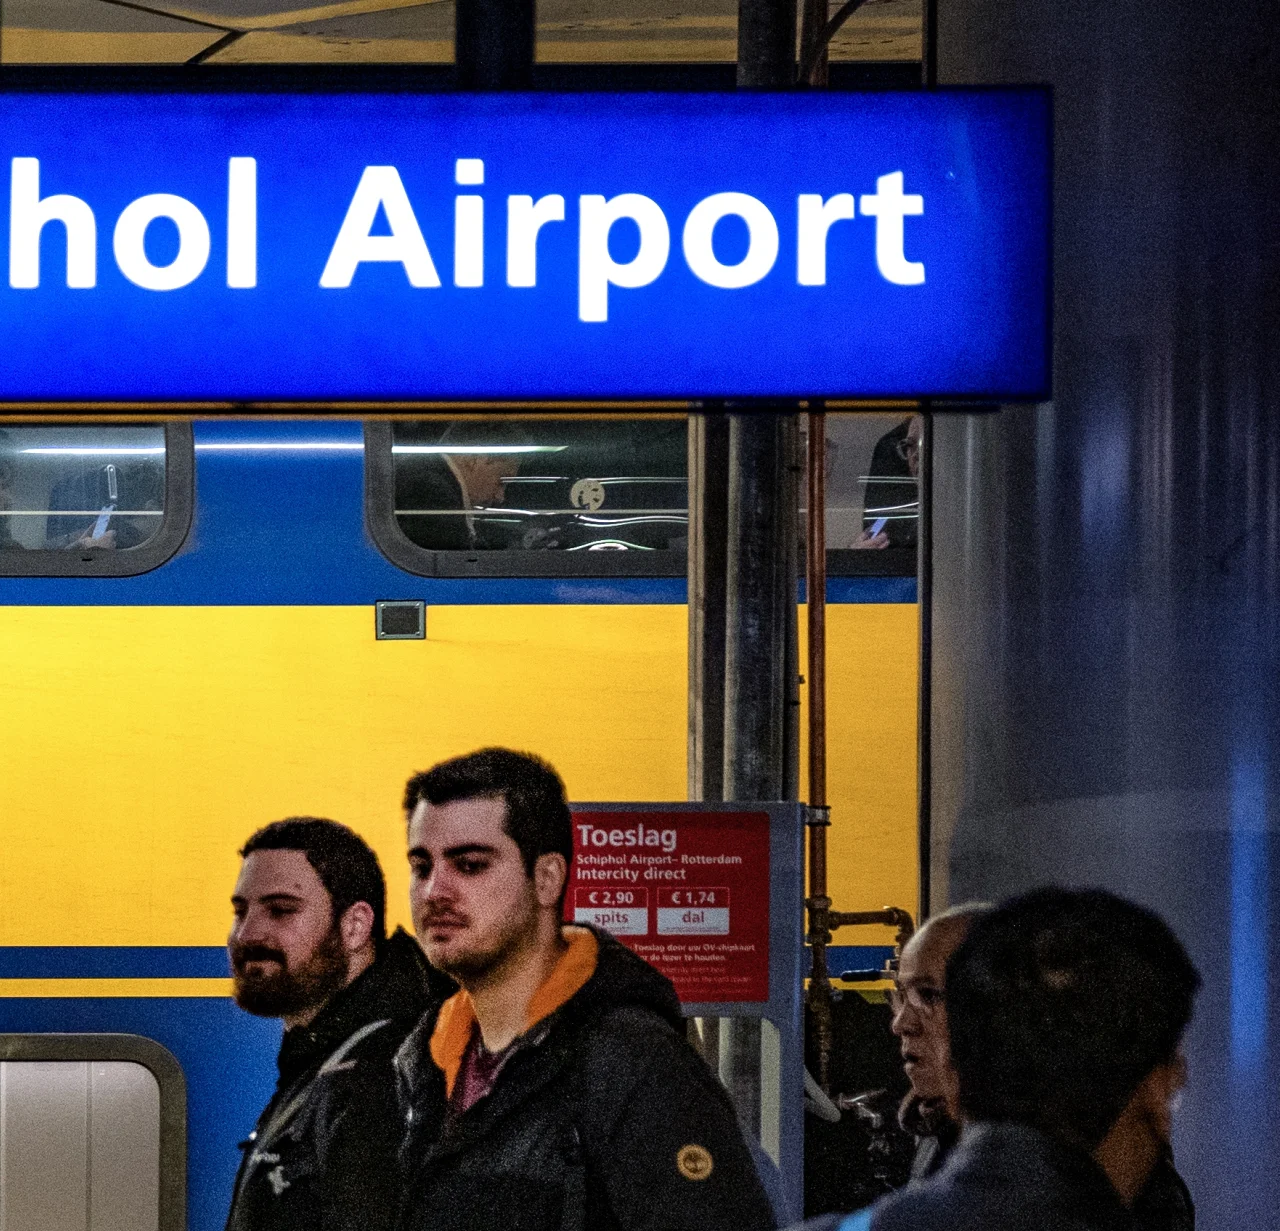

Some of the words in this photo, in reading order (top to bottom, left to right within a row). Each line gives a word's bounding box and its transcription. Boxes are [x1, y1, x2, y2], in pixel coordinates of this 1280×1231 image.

[319, 158, 926, 323] Airport
[576, 823, 677, 852] Toeslag
[576, 854, 627, 866] Schiphol
[681, 854, 743, 865] Rotterdam
[576, 867, 639, 883] Intercity
[643, 866, 687, 880] direct
[588, 891, 598, 904] €
[602, 891, 634, 905] 2,90
[671, 891, 681, 904] €
[685, 891, 716, 905] 1,74
[593, 911, 629, 925] spits
[681, 911, 705, 923] dal
